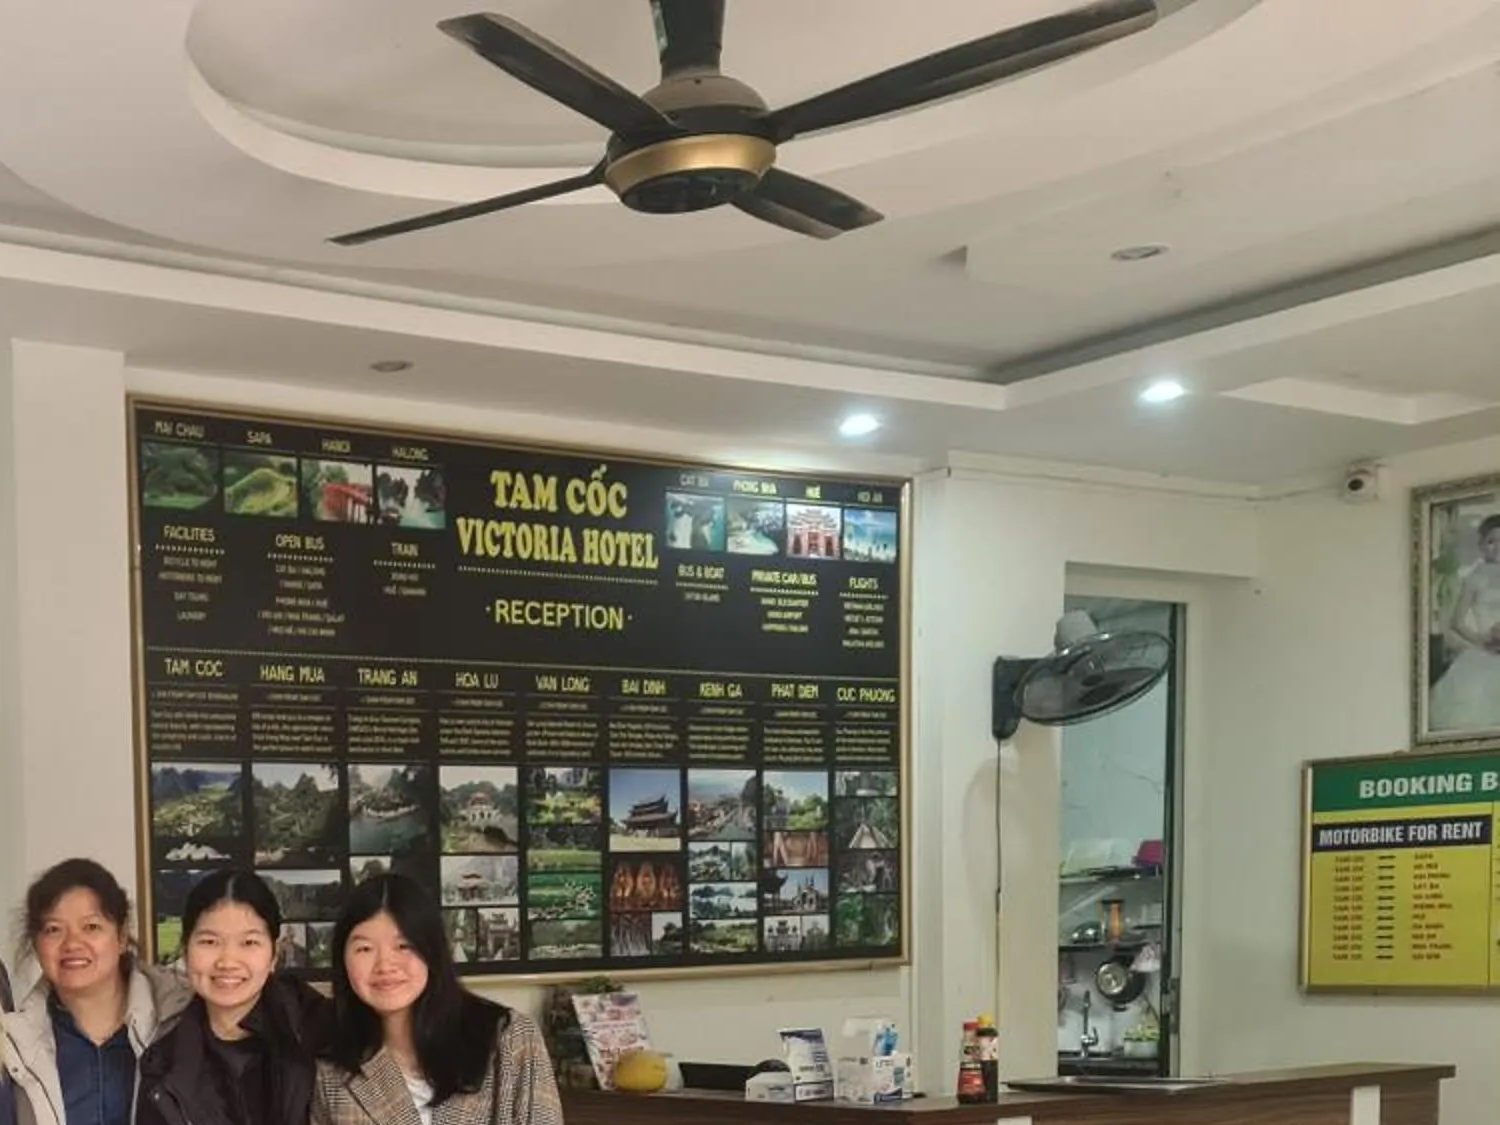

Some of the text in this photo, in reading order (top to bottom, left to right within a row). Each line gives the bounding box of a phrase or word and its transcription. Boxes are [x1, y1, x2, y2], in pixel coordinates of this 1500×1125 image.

[490, 464, 627, 518] TAM CỐC
[456, 516, 659, 569] VICTORIA HOTEL
[495, 599, 623, 630] RECEPTION
[164, 658, 223, 677] TAM COC
[260, 664, 325, 682] HANG MUA
[358, 668, 418, 686] TRANG AN
[455, 672, 499, 689] HOA LU
[536, 676, 590, 692] VAN LONG
[727, 683, 743, 698] GA
[836, 687, 856, 701] CUC
[1359, 773, 1473, 799] BOOKING
[1319, 821, 1484, 846] MOTORBIKE FOR RENT
